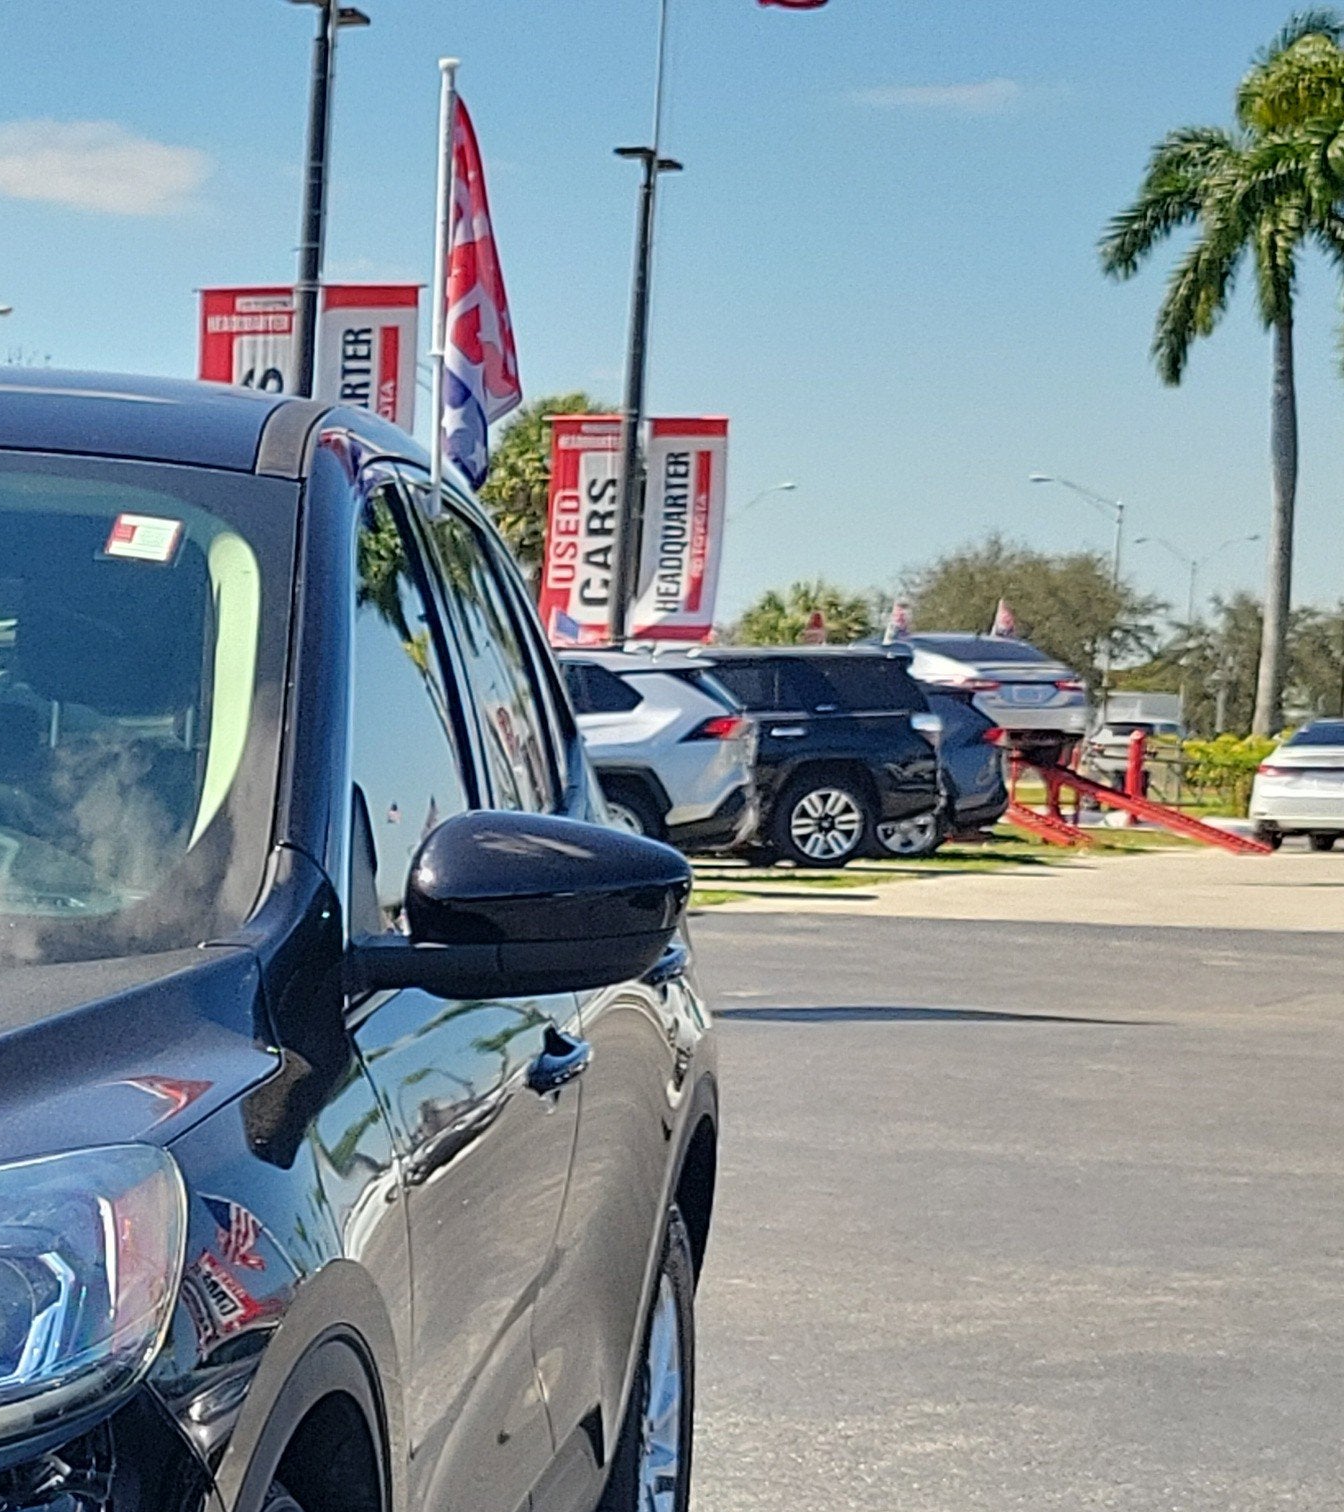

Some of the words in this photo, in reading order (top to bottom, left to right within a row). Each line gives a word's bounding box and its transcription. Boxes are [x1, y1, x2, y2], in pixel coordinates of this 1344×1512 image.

[551, 490, 581, 584] USED
[579, 477, 617, 607] CARS
[653, 451, 691, 613] HEADQUARTER
